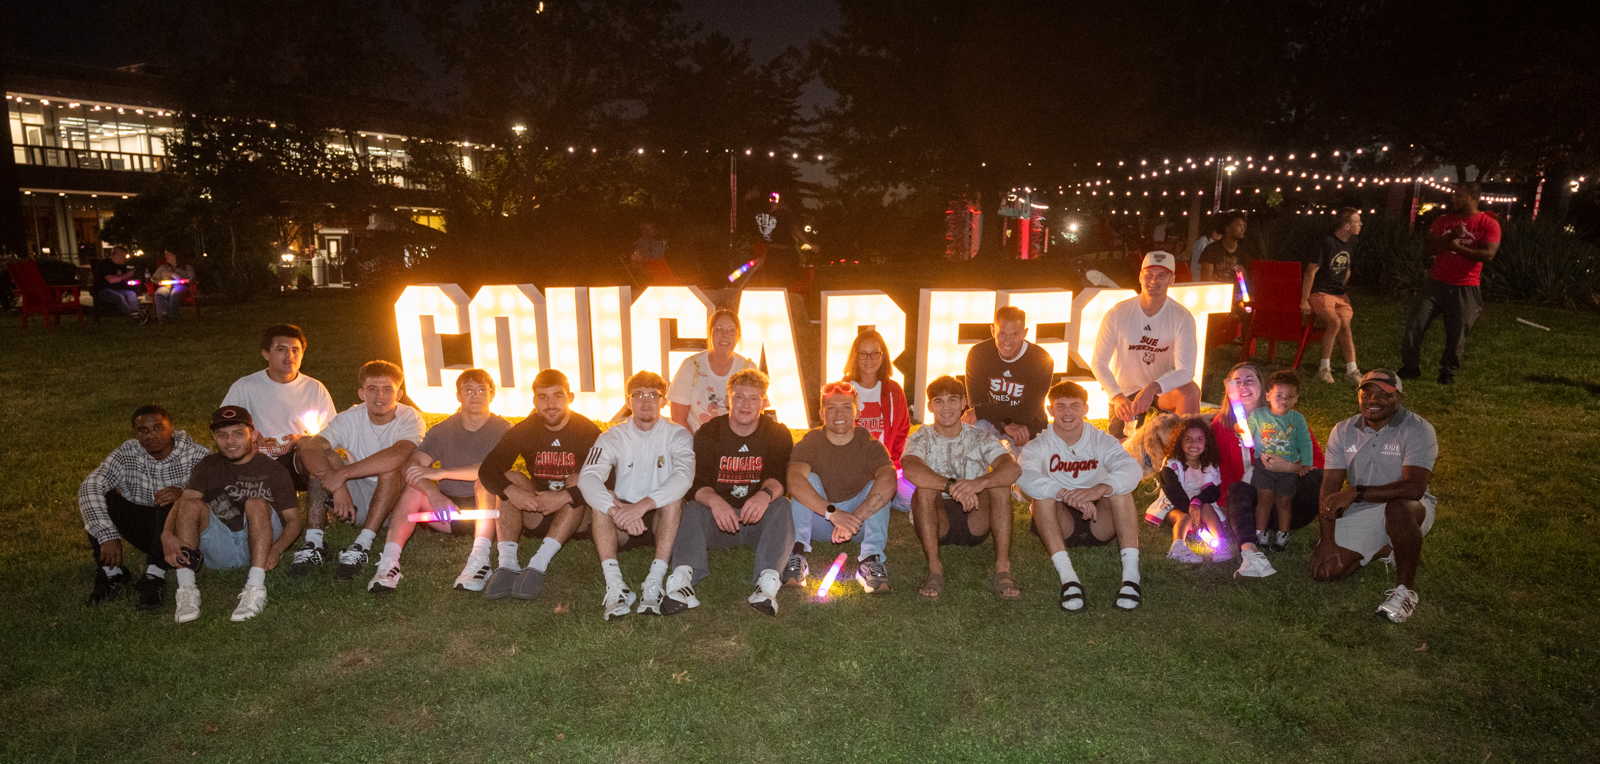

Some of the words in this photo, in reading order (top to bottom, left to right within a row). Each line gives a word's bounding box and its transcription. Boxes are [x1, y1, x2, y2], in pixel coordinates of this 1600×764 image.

[535, 451, 576, 467] COUGARS
[720, 456, 763, 471] COUGARS
[1050, 454, 1099, 478] Cougars
